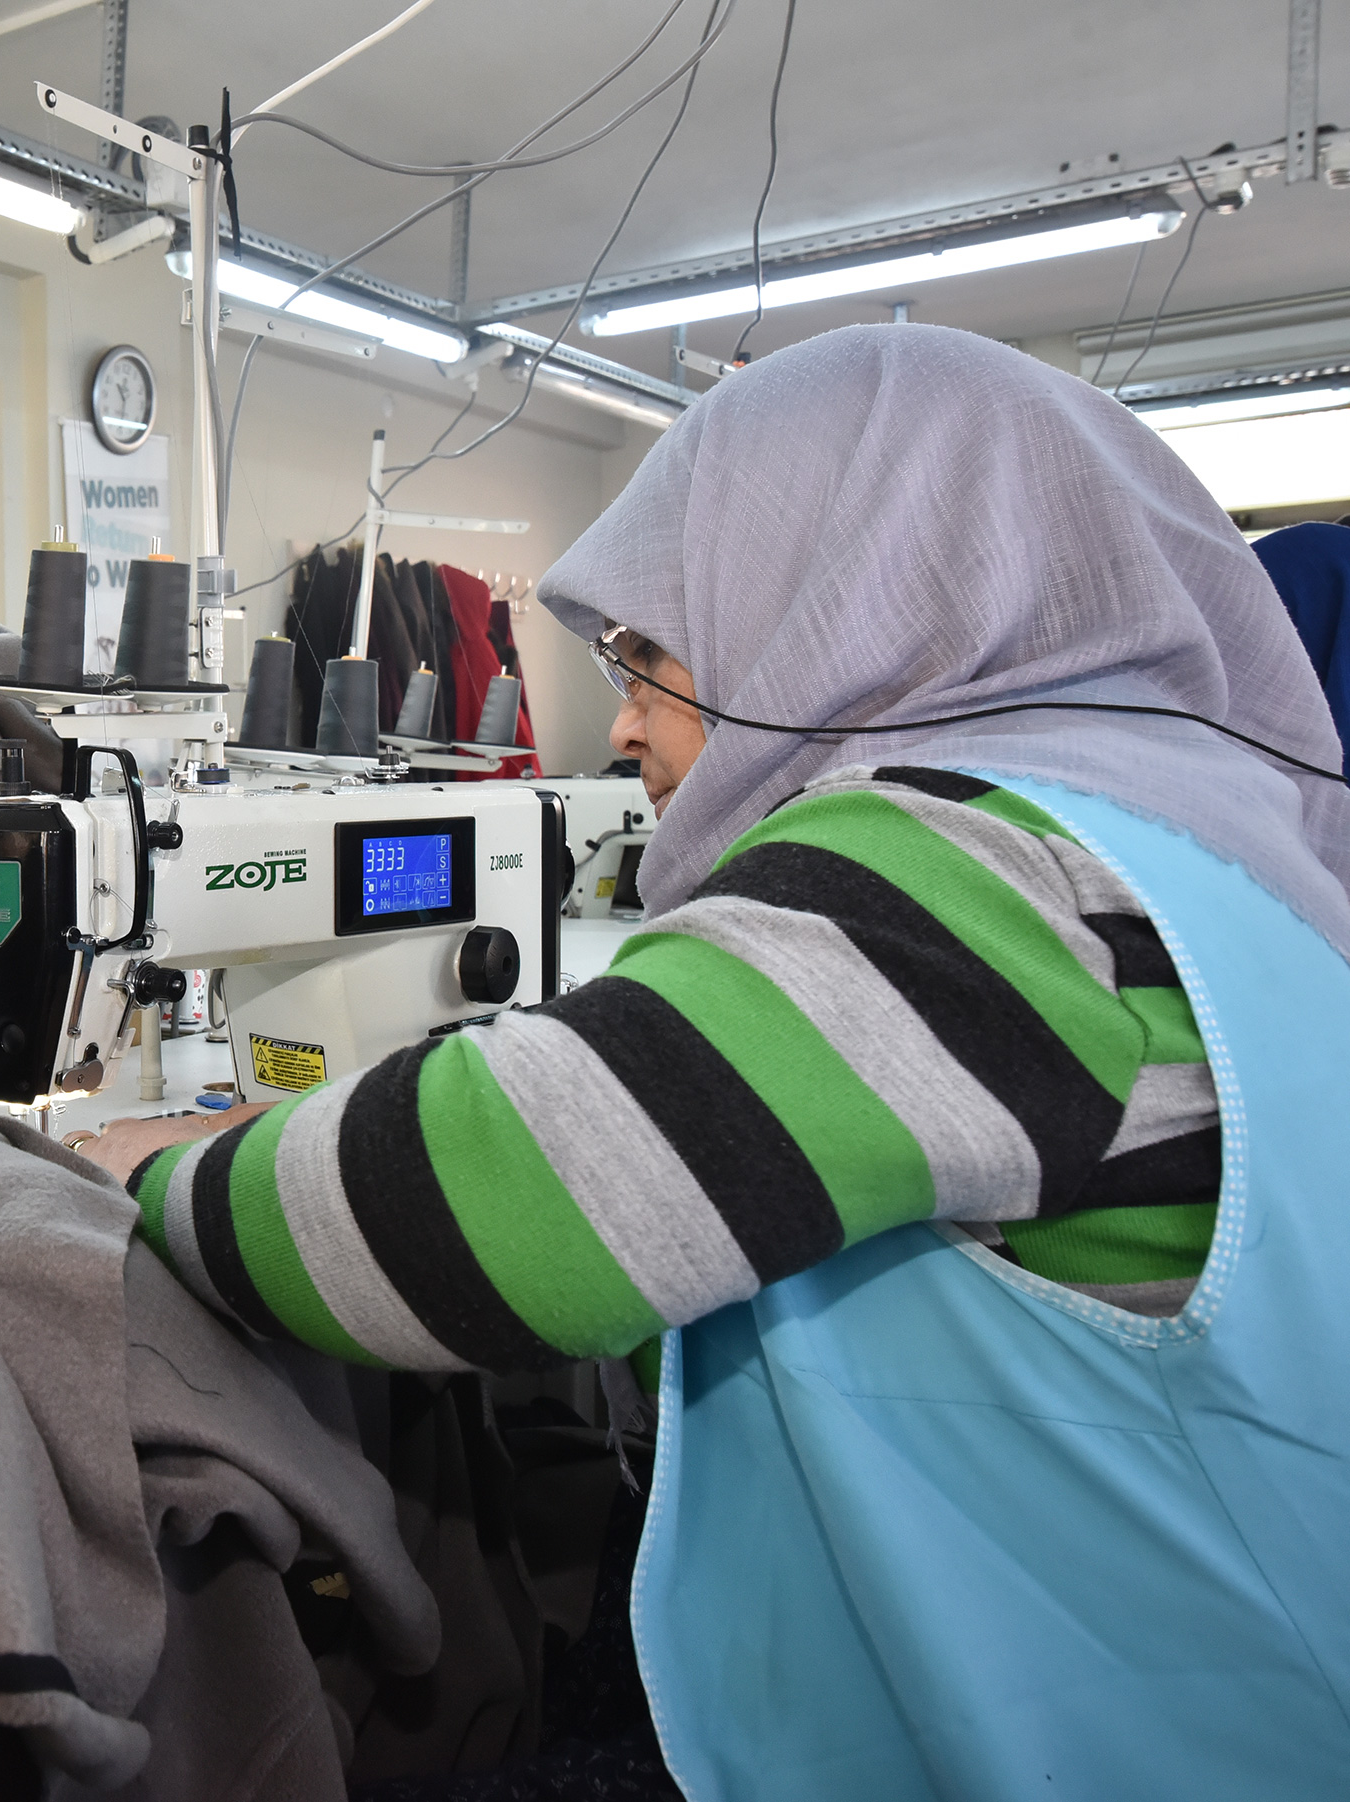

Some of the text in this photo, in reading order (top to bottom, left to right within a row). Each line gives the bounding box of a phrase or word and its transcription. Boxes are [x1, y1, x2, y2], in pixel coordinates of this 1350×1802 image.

[80, 480, 159, 509] Women
[87, 565, 100, 588] o
[285, 848, 307, 857] MACHINE
[366, 847, 405, 873] 3333
[490, 853, 523, 871] ZJ8000E
[205, 858, 307, 891] ZOJE
